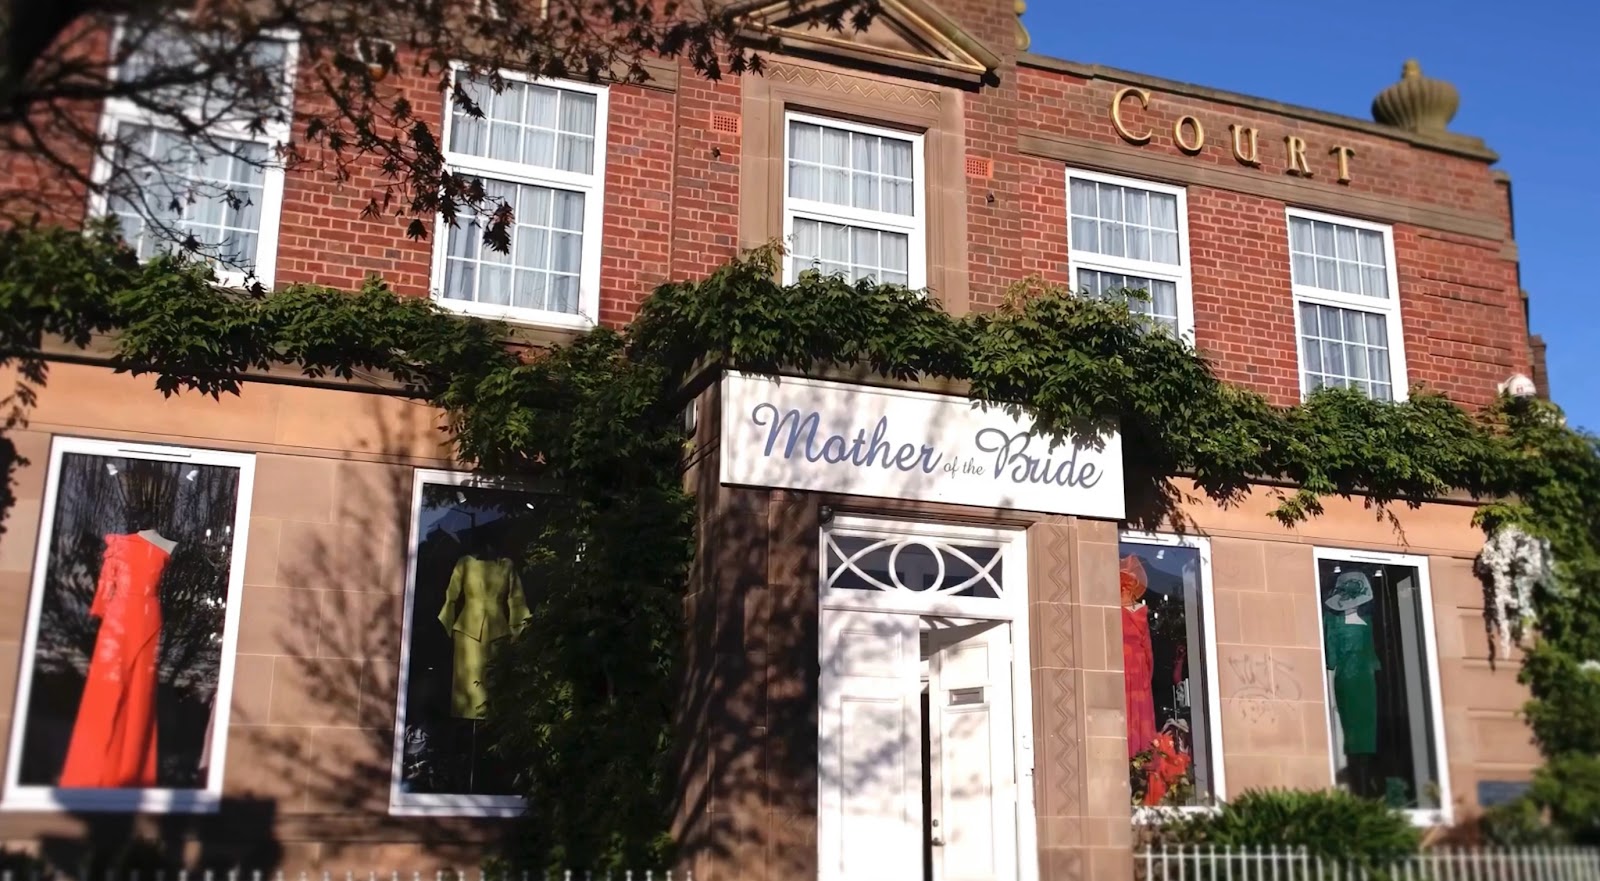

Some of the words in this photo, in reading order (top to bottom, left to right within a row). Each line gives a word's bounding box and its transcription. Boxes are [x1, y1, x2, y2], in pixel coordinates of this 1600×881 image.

[1110, 87, 1356, 186] COURT
[752, 402, 943, 474] Mother
[943, 456, 960, 480] of
[962, 457, 986, 476] the
[975, 427, 1104, 489] Bride
